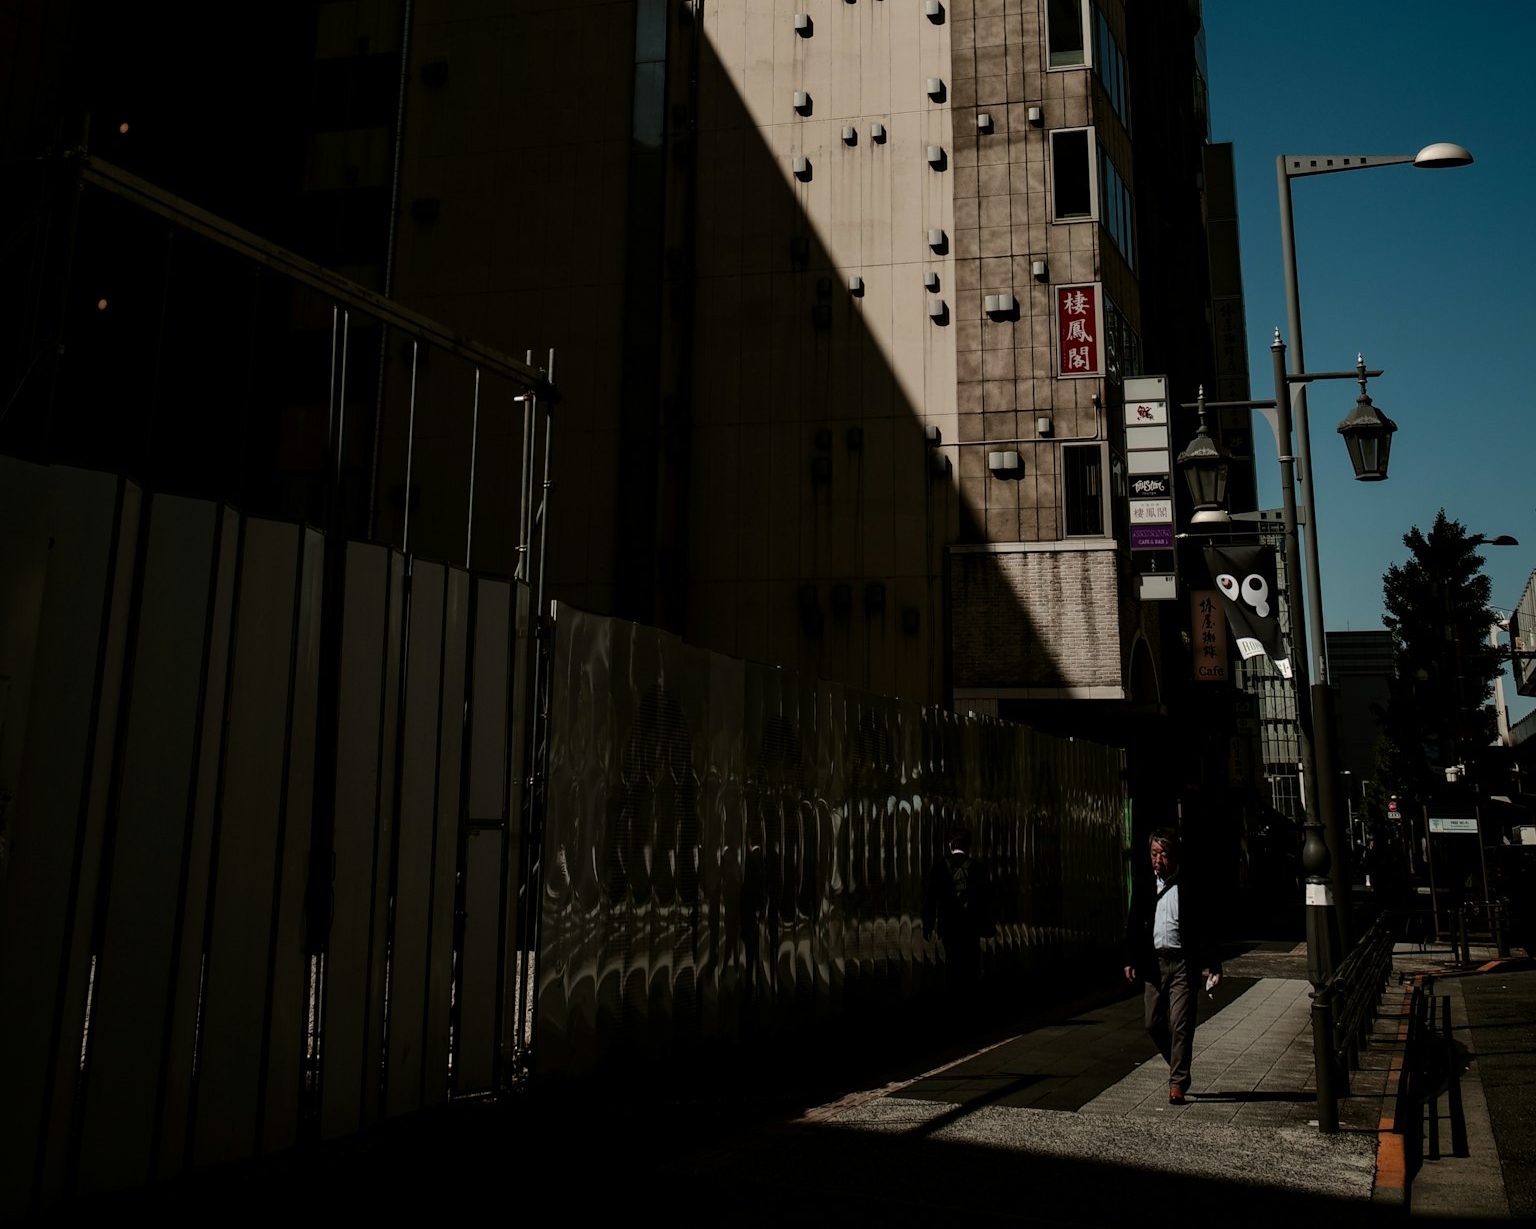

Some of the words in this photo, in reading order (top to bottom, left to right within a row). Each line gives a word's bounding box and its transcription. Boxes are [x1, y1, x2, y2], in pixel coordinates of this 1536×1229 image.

[1063, 290, 1093, 370] 棲鳳閣
[1199, 665, 1225, 676] Cafe
